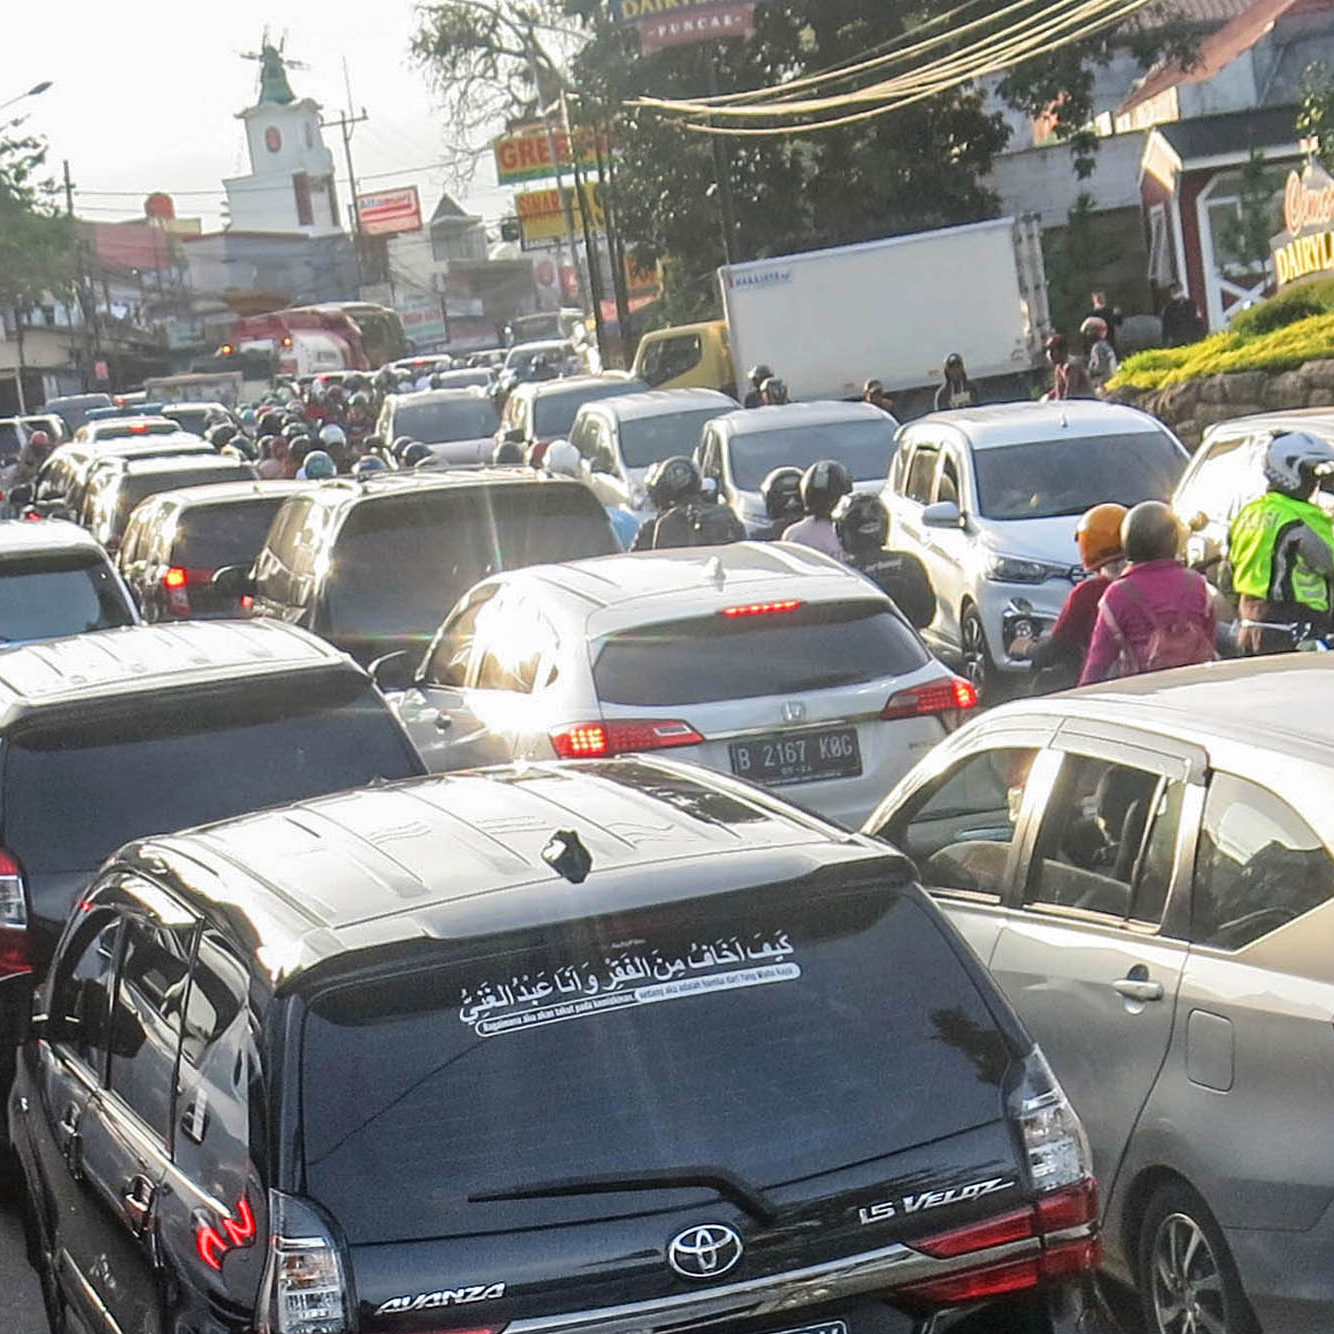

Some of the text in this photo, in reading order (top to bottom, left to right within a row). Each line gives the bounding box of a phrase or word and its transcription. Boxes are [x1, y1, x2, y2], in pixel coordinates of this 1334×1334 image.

[739, 748, 751, 770] B
[764, 741, 807, 768] 2167
[902, 1177, 1015, 1213] VELOZ
[374, 1282, 505, 1315] AVANZA
